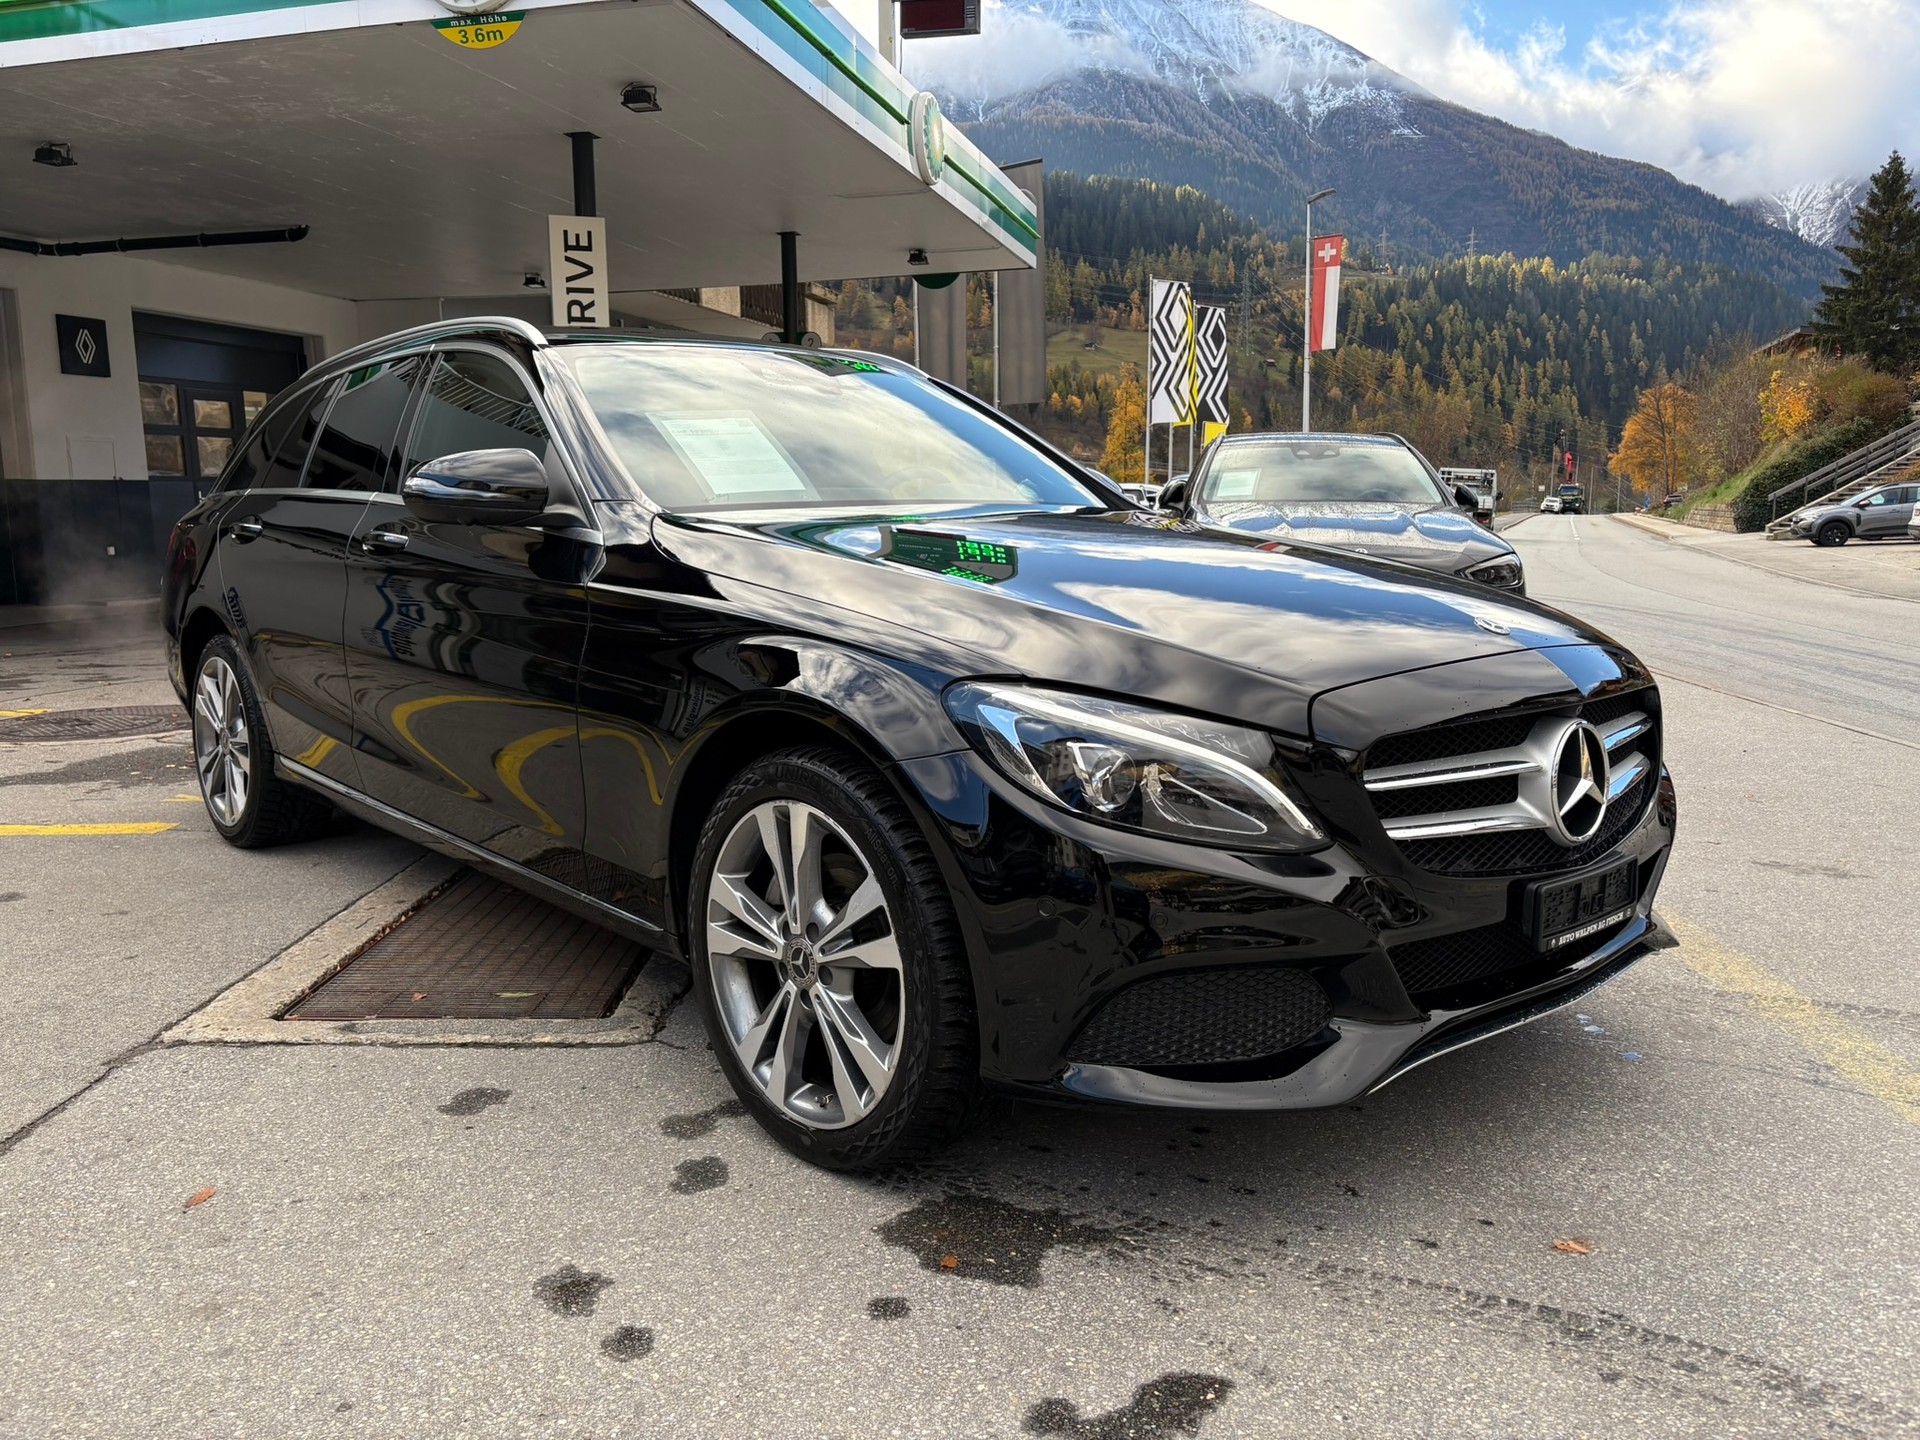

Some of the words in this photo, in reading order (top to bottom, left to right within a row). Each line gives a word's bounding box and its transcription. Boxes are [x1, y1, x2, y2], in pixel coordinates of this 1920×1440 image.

[450, 18, 476, 27] max.
[480, 14, 508, 24] Höhe
[458, 27, 504, 44] 3.6m
[1558, 932, 1575, 945] AUTO
